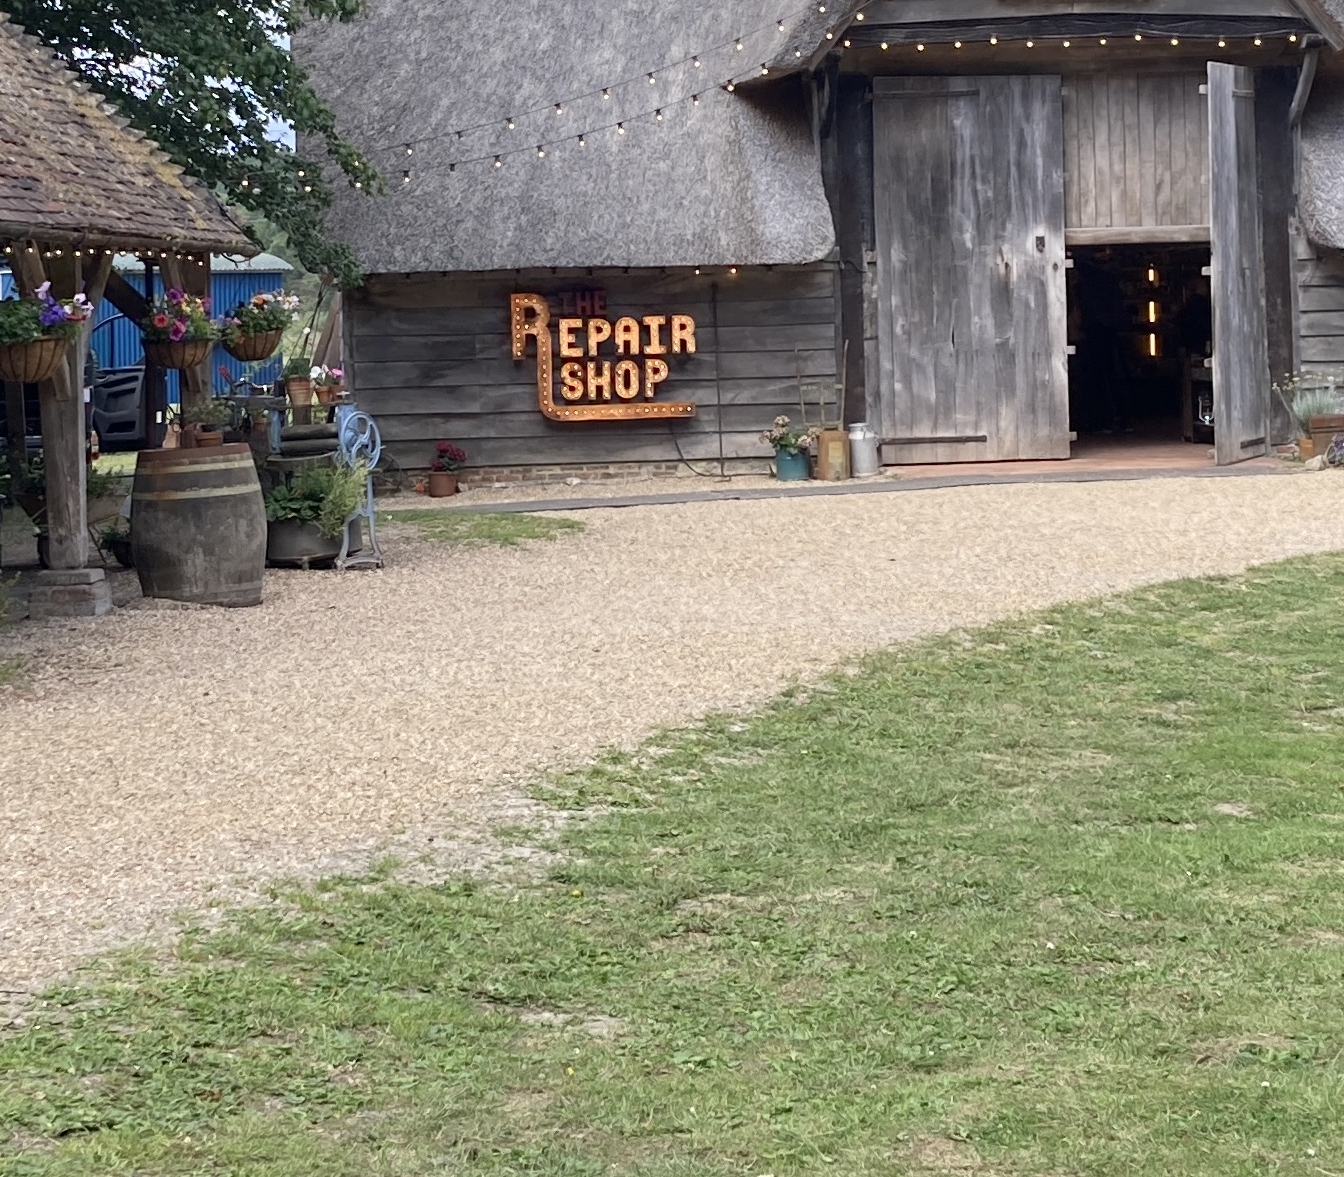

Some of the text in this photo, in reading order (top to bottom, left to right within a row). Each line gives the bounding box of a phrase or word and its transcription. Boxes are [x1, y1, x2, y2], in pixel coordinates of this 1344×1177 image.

[560, 291, 605, 316] THE
[510, 293, 696, 421] REPAIR
[560, 358, 669, 401] SHOP
